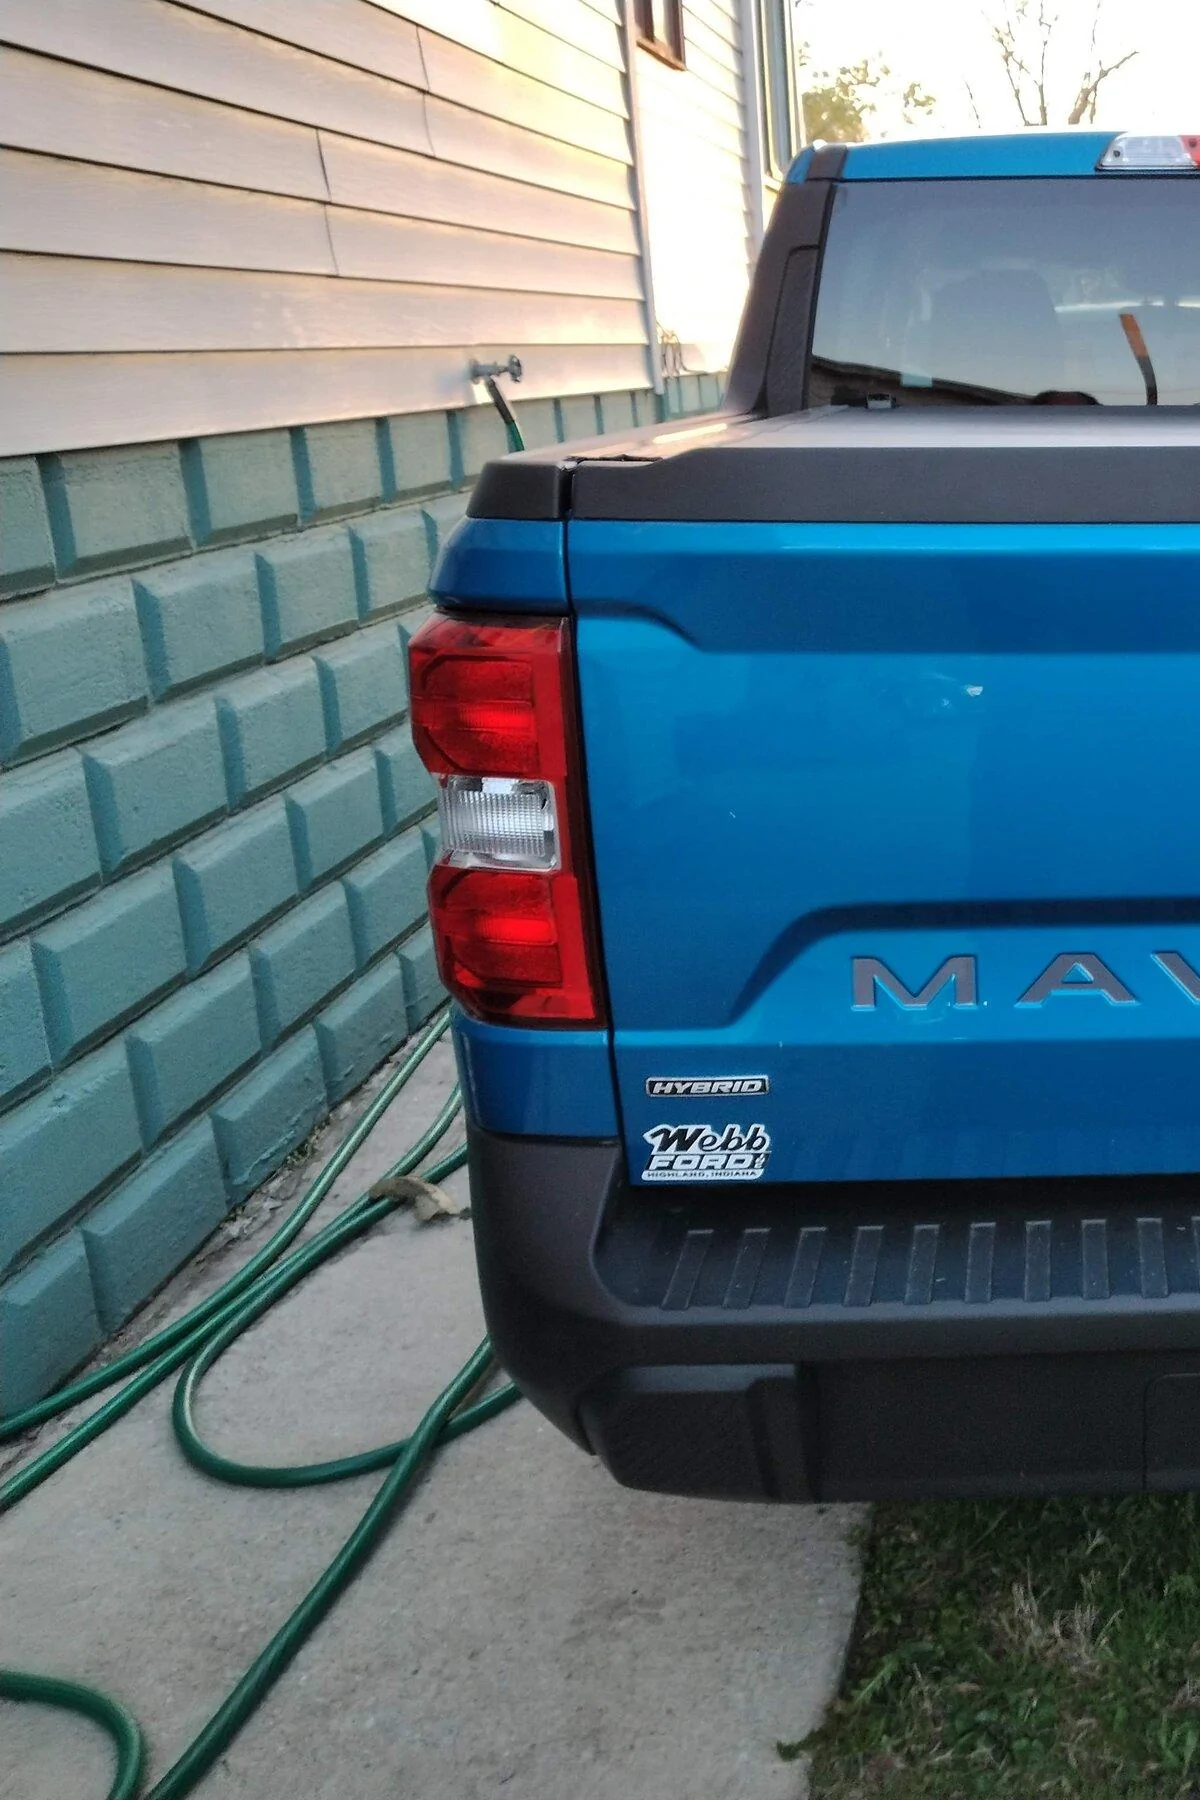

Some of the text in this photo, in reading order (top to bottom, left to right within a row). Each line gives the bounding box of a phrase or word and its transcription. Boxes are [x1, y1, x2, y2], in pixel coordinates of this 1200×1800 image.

[652, 1080, 762, 1093] HYBRID
[650, 1126, 767, 1152] Webb
[648, 1154, 753, 1170] FORD
